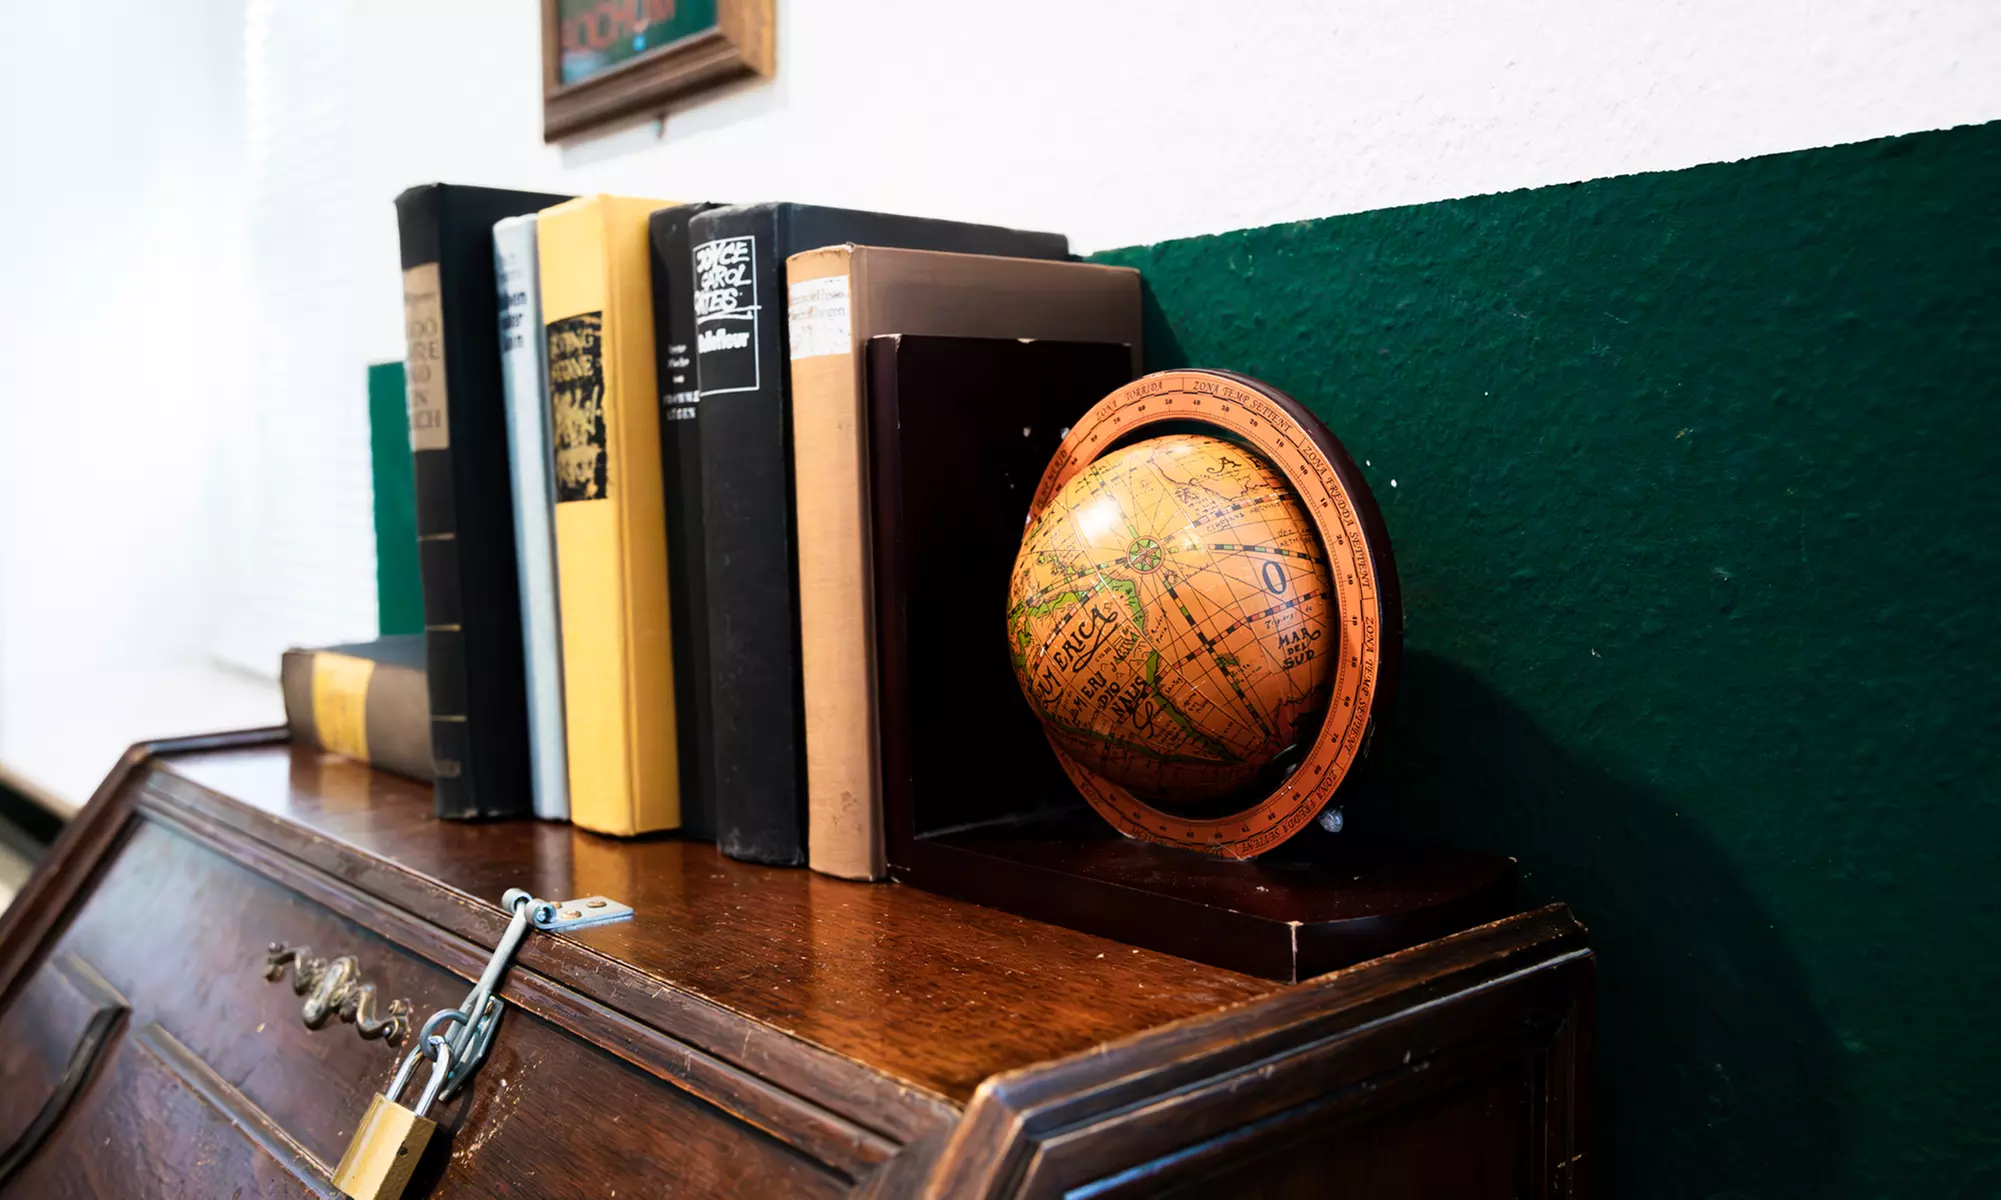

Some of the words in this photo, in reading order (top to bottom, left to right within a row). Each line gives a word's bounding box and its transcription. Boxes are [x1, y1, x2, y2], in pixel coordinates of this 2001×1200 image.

[697, 240, 751, 273] JOYCE
[701, 263, 752, 291] CAROL
[1193, 381, 1219, 395] ZONA
[1222, 386, 1250, 403] TEMP
[1303, 446, 1327, 475] ZONA
[1326, 477, 1355, 527] FREDDA
[1261, 560, 1287, 594] O
[1365, 616, 1375, 653] ZONA
[1283, 649, 1315, 670] SUD
[1362, 659, 1374, 697] TEMP
